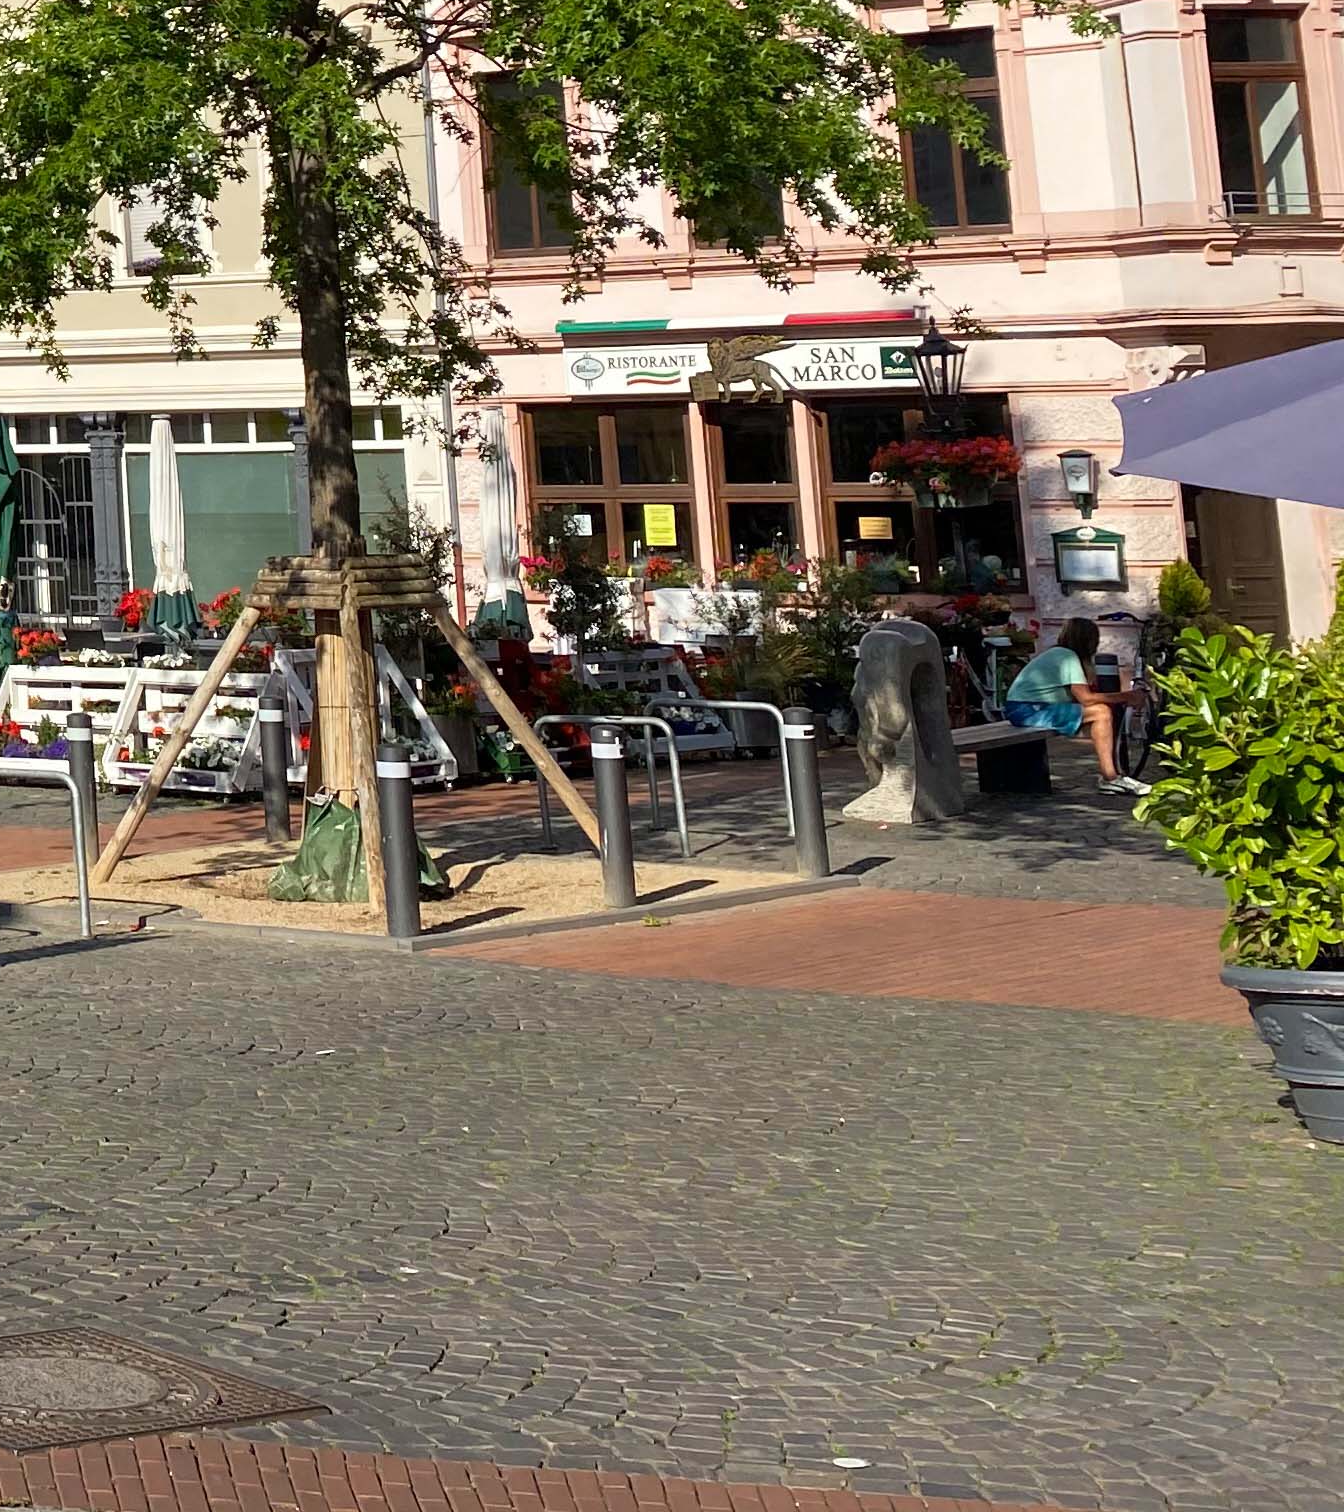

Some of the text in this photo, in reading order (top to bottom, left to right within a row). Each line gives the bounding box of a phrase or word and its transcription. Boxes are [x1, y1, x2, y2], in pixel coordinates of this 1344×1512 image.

[607, 355, 697, 369] RISTORANTE
[810, 347, 856, 364] SAN
[792, 363, 877, 382] MARCO
